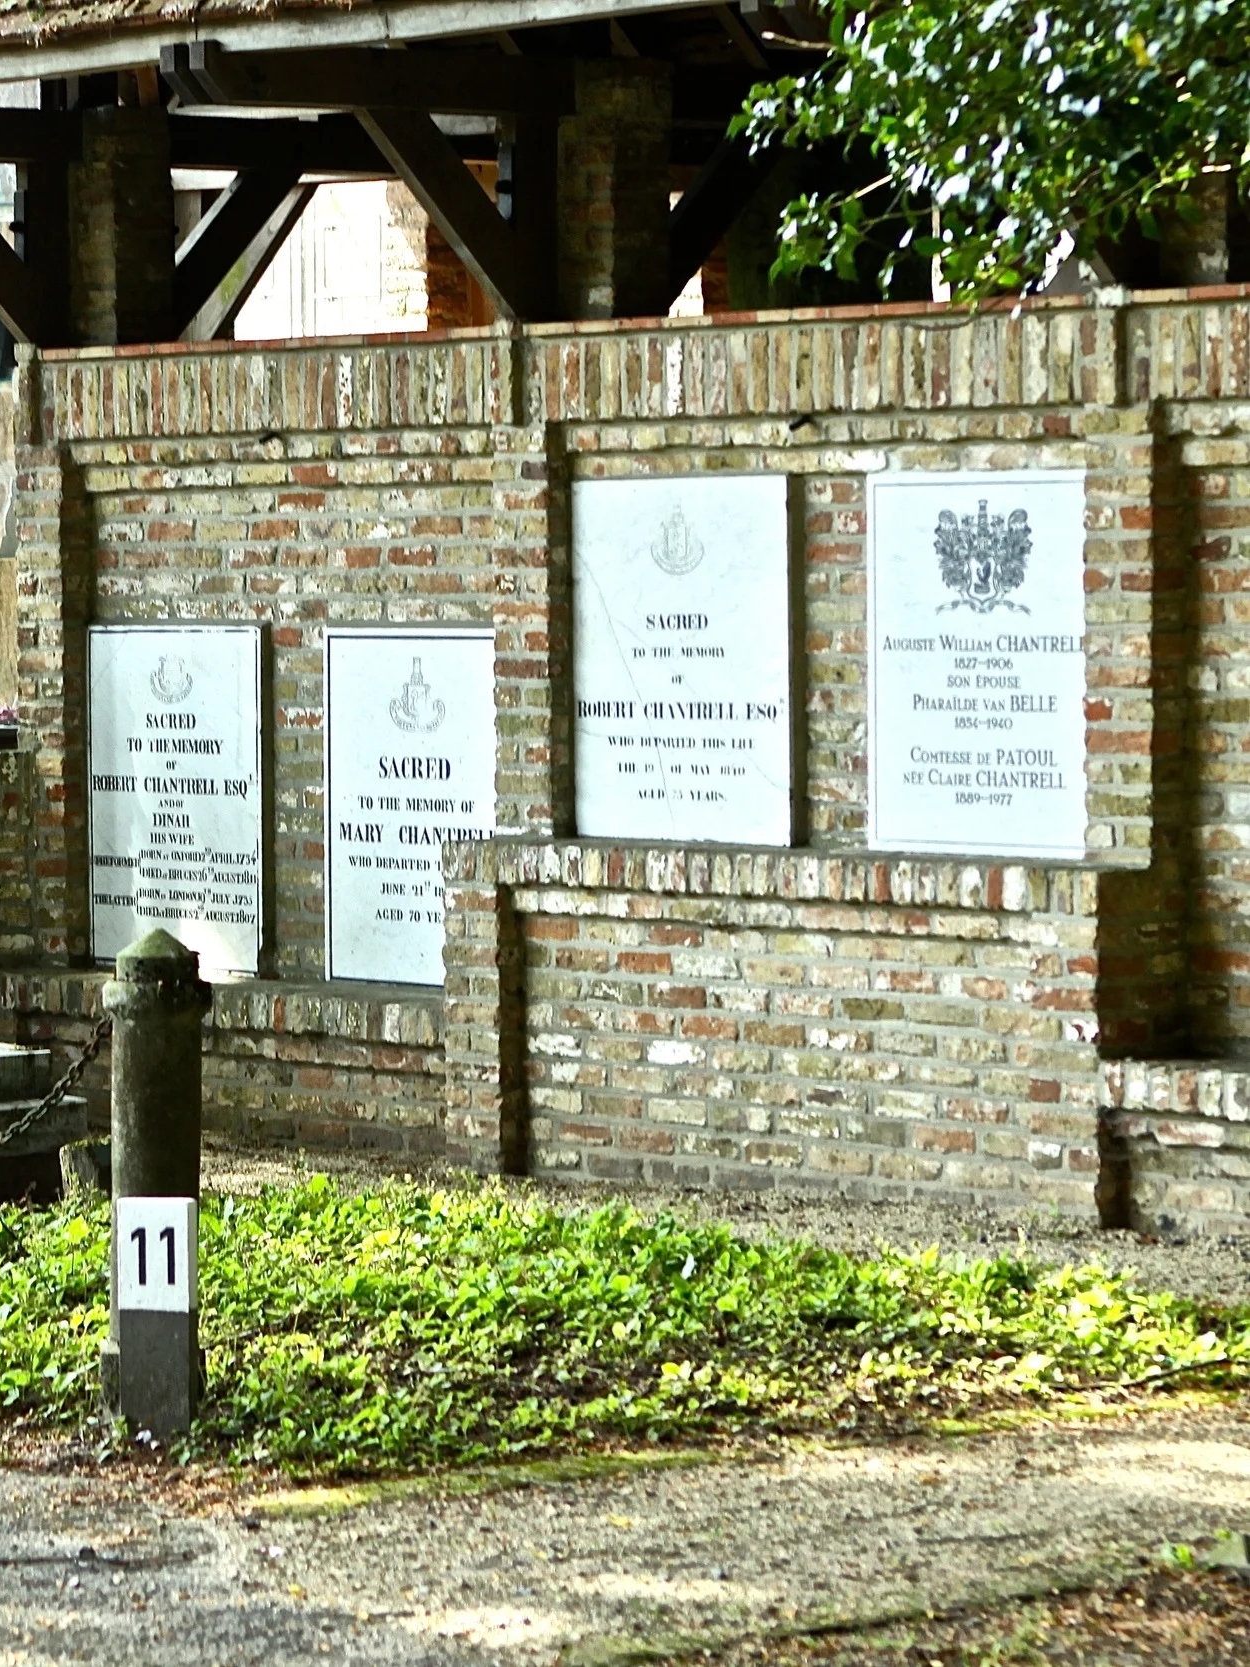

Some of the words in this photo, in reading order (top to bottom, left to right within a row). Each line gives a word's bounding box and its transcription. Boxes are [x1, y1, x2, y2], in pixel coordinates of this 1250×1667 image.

[646, 613, 708, 631] SACRED
[631, 647, 645, 659] TO
[651, 647, 674, 658] THE
[681, 647, 725, 658] MEMORY
[671, 674, 684, 684] OF
[947, 675, 970, 688] SON
[578, 701, 636, 719] ROBERT
[644, 702, 738, 720] CHANTRELL
[1010, 695, 1057, 713] BELLE
[146, 712, 196, 730] SACRED
[127, 737, 142, 753] TO
[148, 739, 170, 754] THE
[171, 738, 224, 755] MEMORY
[608, 736, 634, 748] WHO
[640, 736, 696, 749] DEPARTED
[701, 737, 726, 749] THIS
[731, 738, 755, 749] LIFE
[166, 760, 177, 771] OF
[996, 749, 1058, 767] PATOUL
[379, 755, 450, 781] SACRED
[617, 762, 638, 774] THE
[671, 764, 681, 774] OF
[690, 764, 710, 775] MAY
[93, 775, 137, 792] ROBERT
[144, 776, 218, 796] CHANTRELL
[976, 770, 1067, 789] CHANTRELL
[637, 789, 664, 800] AGED
[158, 799, 175, 808] AND
[175, 799, 184, 808] OF
[357, 795, 373, 810] TO
[378, 796, 400, 812] THE
[406, 797, 456, 813] MEMORY
[461, 800, 474, 814] OF
[153, 813, 190, 828] DINAH
[150, 832, 167, 845] HIS
[169, 832, 194, 846] WIFE
[339, 822, 384, 843] MARY
[348, 855, 371, 868] WHO
[376, 856, 430, 871] DEPARTED
[380, 882, 406, 896] JUNE
[375, 908, 403, 921] AGED
[409, 910, 421, 923] 70
[131, 1227, 175, 1286] 11
